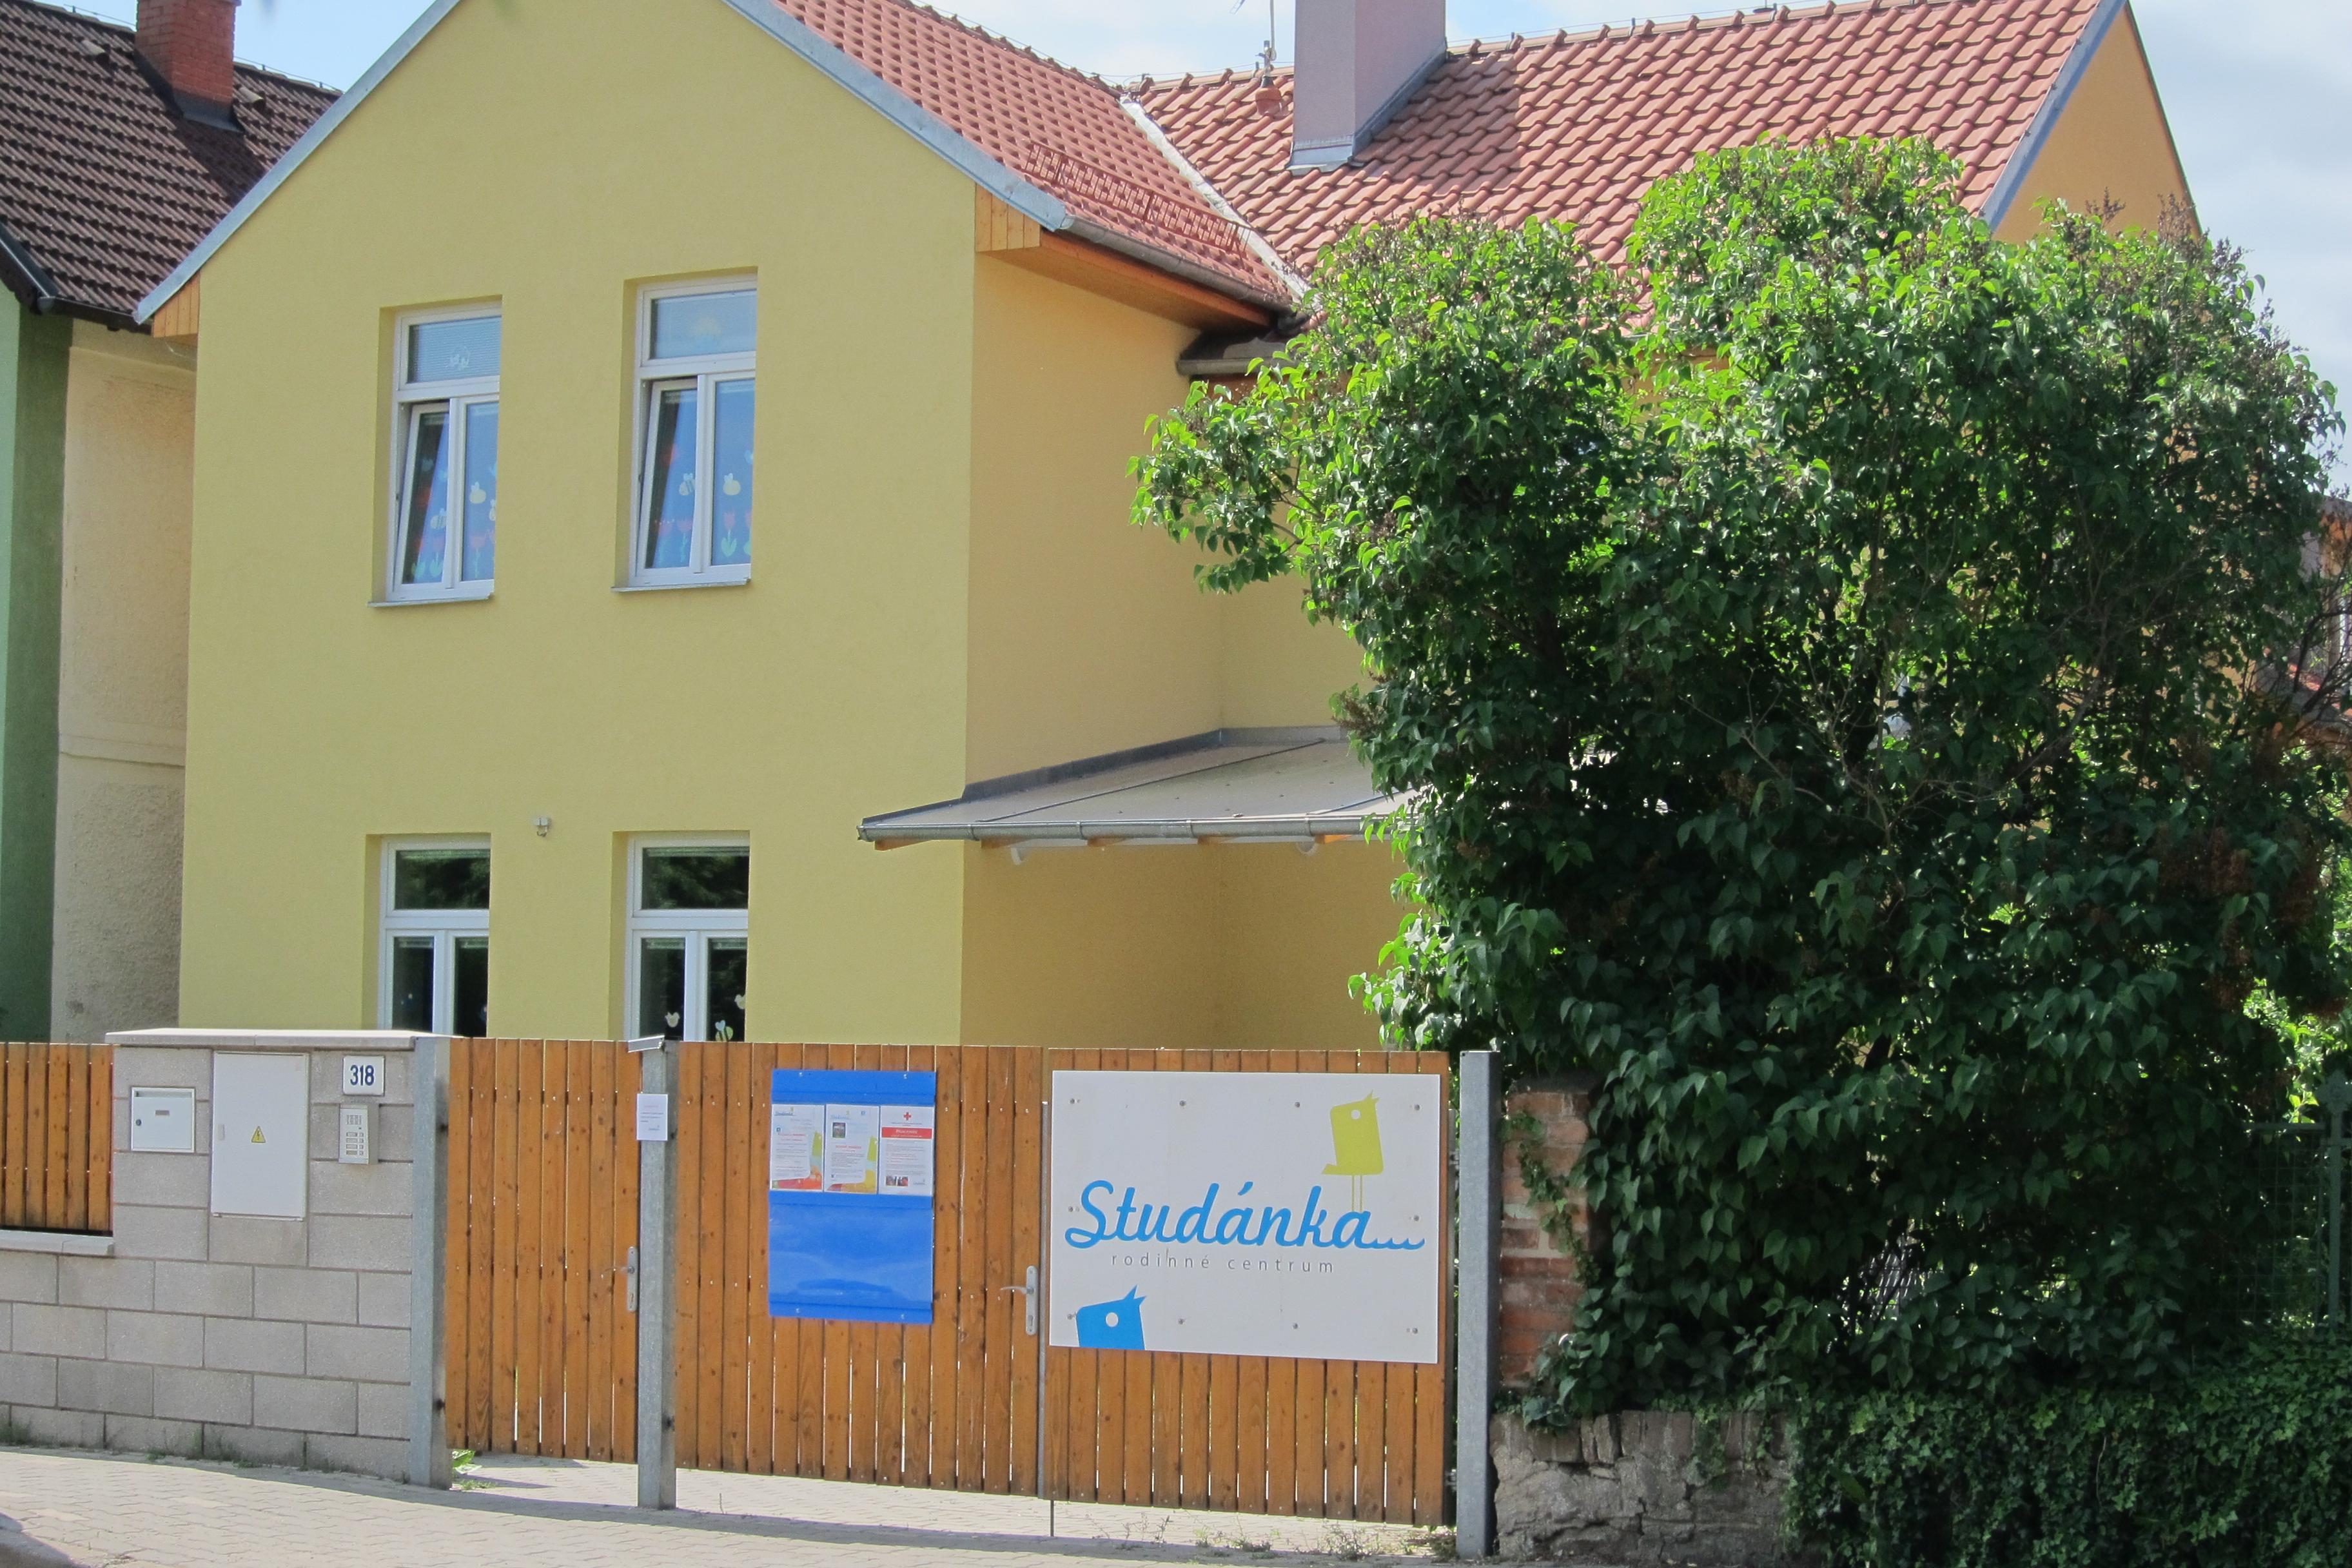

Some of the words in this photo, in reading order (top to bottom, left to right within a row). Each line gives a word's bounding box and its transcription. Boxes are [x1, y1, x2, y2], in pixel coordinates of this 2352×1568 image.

[350, 1064, 375, 1086] 318
[1064, 1179, 1426, 1249] Studánka
[1111, 1252, 1210, 1269] rodinné
[1227, 1258, 1333, 1273] centrum
